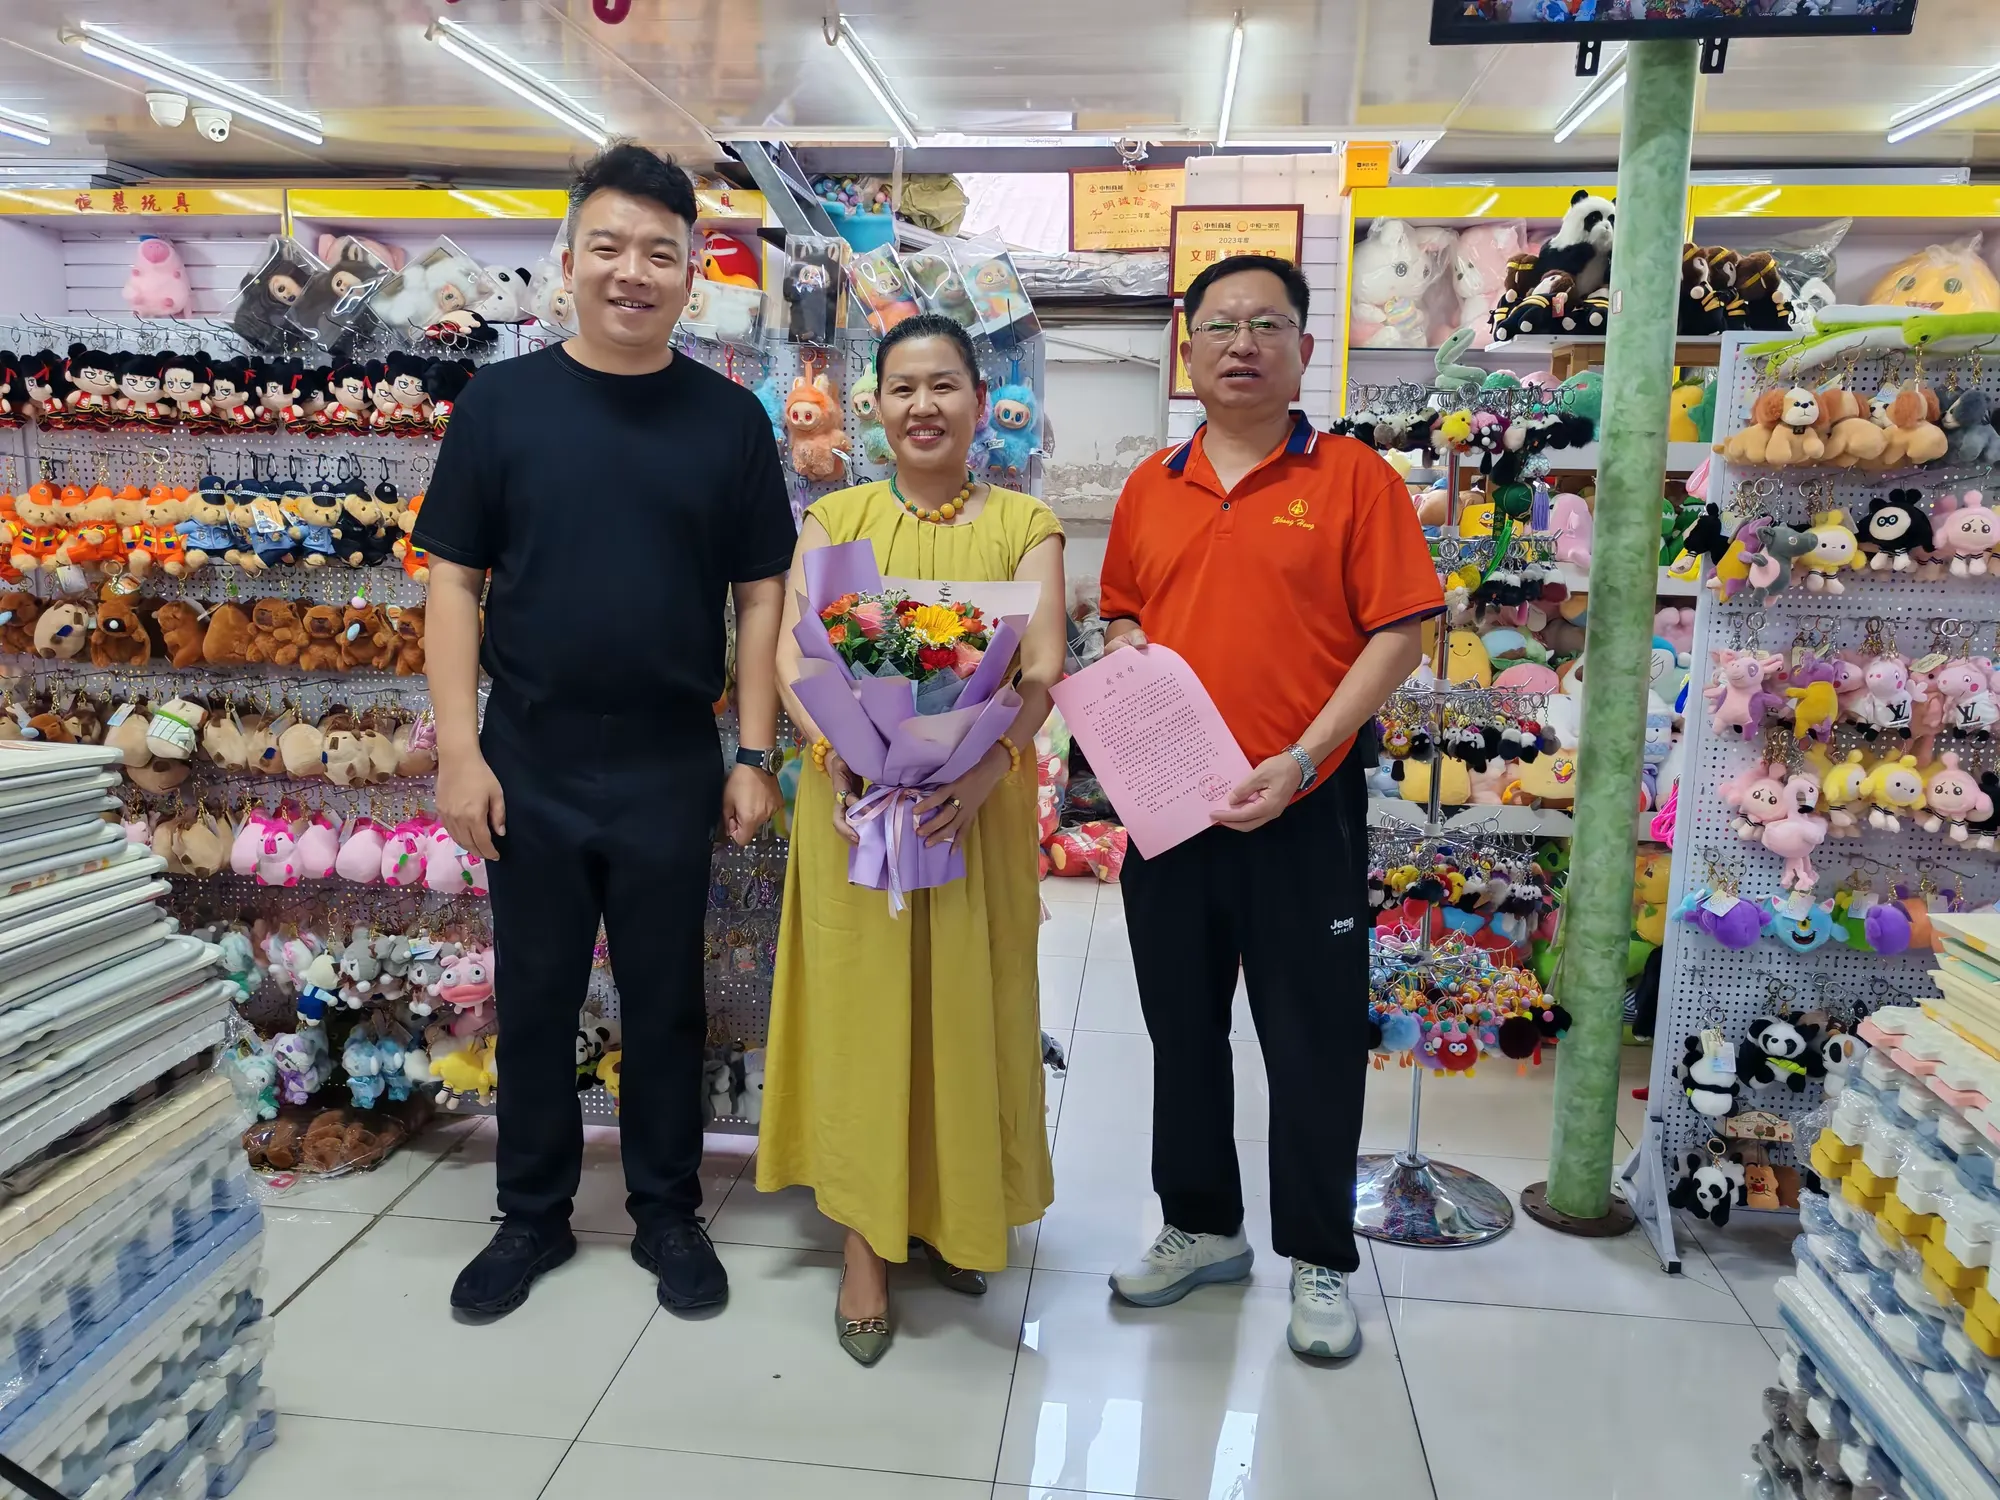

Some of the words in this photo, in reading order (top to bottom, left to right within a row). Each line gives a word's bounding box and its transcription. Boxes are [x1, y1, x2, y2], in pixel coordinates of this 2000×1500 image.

[75, 190, 191, 213] 恒慧玩具
[1204, 221, 1231, 229] 中恒商城
[1330, 916, 1354, 930] Jeep
